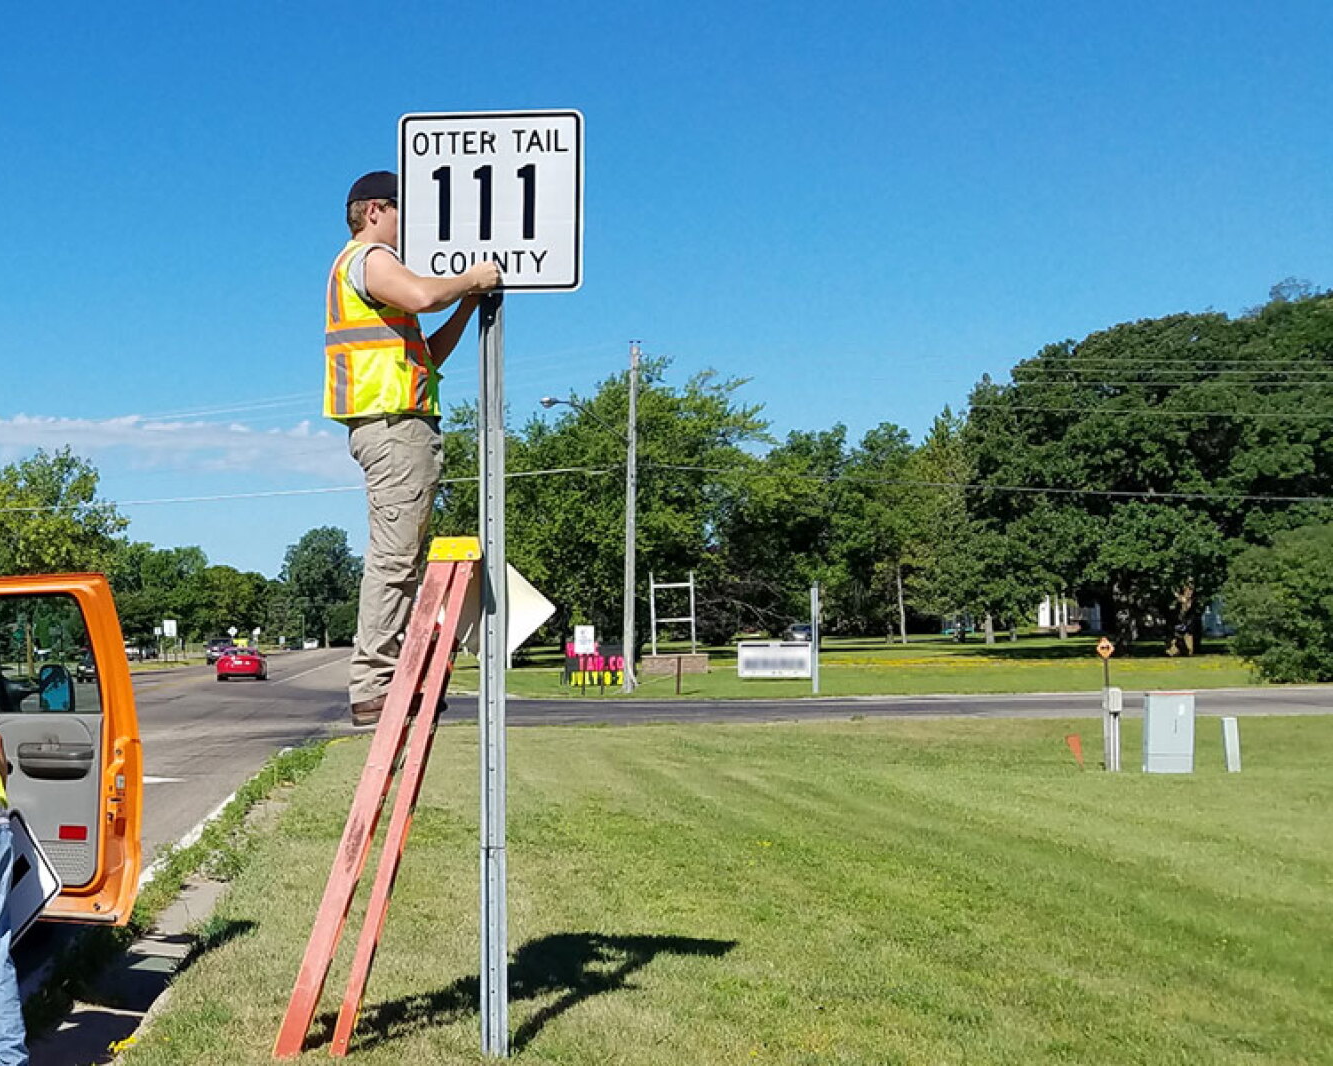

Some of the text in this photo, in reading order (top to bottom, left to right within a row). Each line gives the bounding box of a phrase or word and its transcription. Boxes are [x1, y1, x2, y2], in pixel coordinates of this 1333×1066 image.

[412, 129, 569, 156] OTTER TAIL
[432, 164, 535, 241] 111
